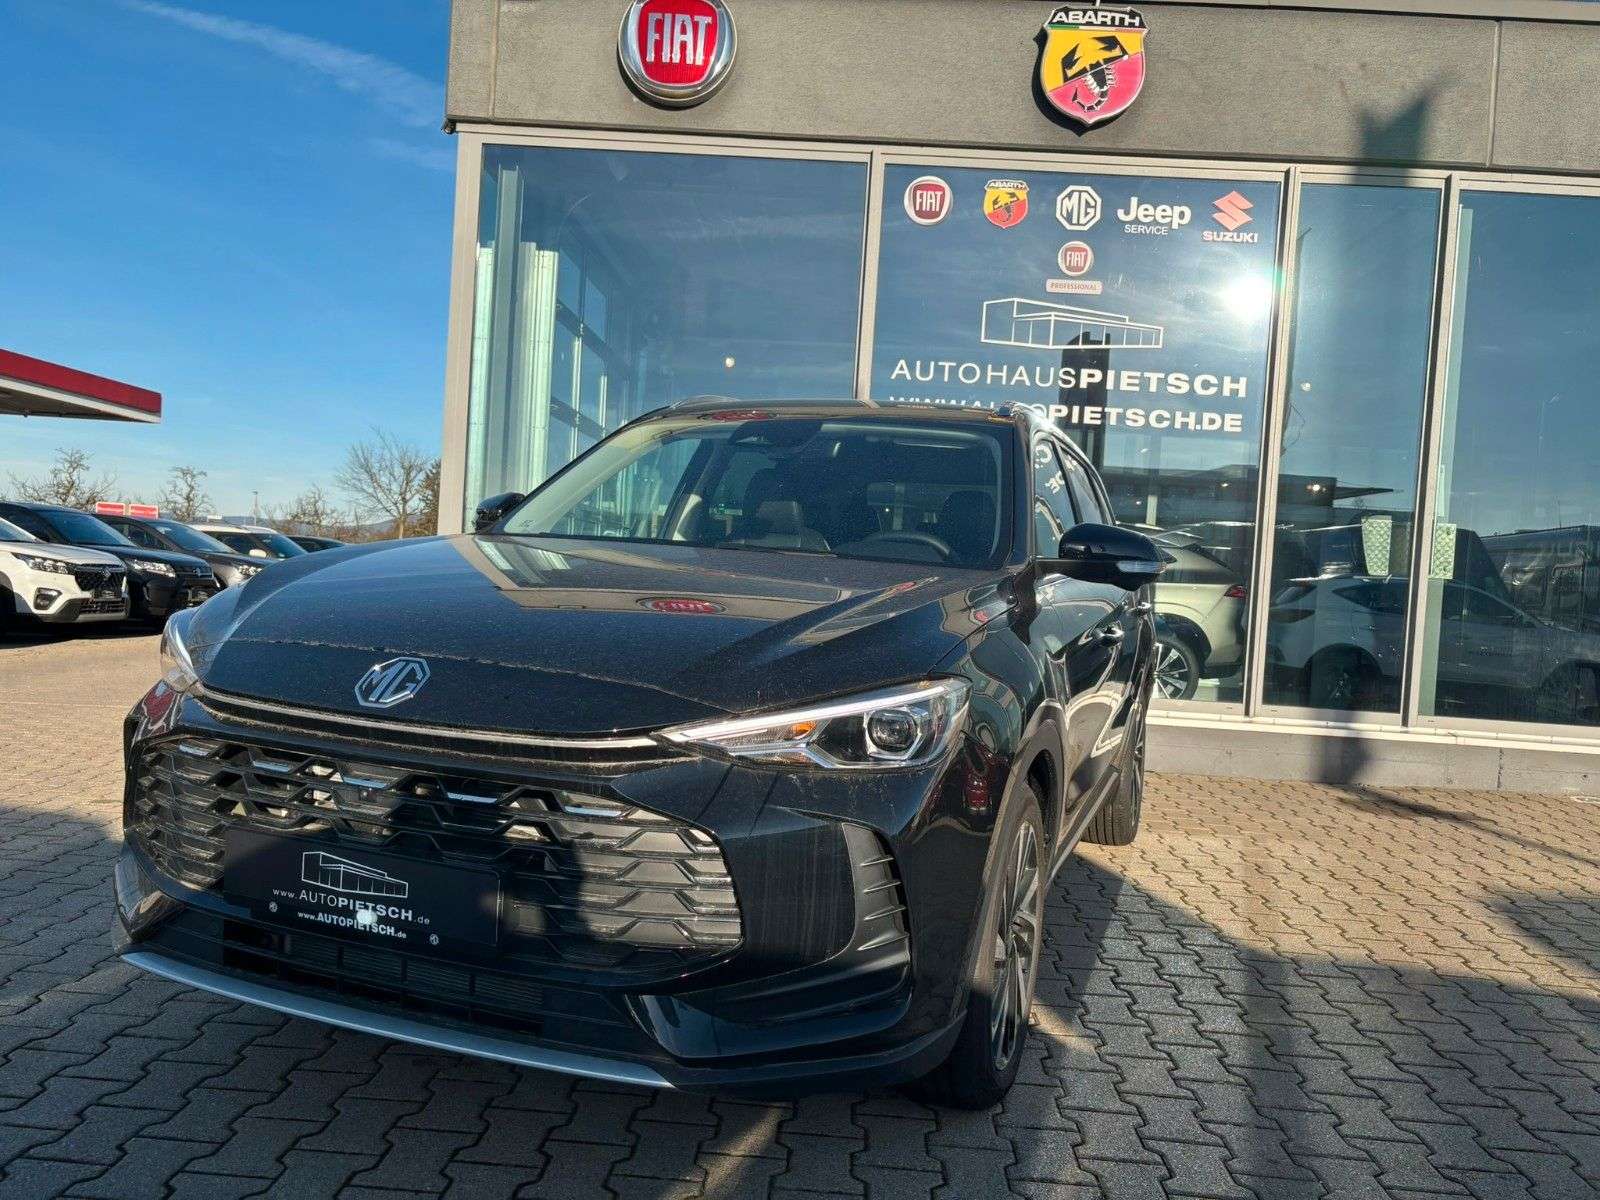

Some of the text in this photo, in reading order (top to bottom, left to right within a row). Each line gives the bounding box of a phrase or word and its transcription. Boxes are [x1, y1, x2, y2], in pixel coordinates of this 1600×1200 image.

[1053, 10, 1140, 27] ABARTH
[646, 12, 712, 66] FIAT
[987, 180, 1027, 191] ABARTH
[915, 189, 943, 212] FIAT
[1060, 190, 1097, 226] MG
[1117, 196, 1191, 229] Jeep
[1124, 223, 1168, 236] SERVICE
[1202, 230, 1259, 243] SUZUKI
[1065, 250, 1088, 267] FIAT
[1050, 281, 1099, 293] PROFESSIONAL
[890, 359, 1247, 398] AUTOHAUSPIETSCH
[362, 658, 423, 703] MG
